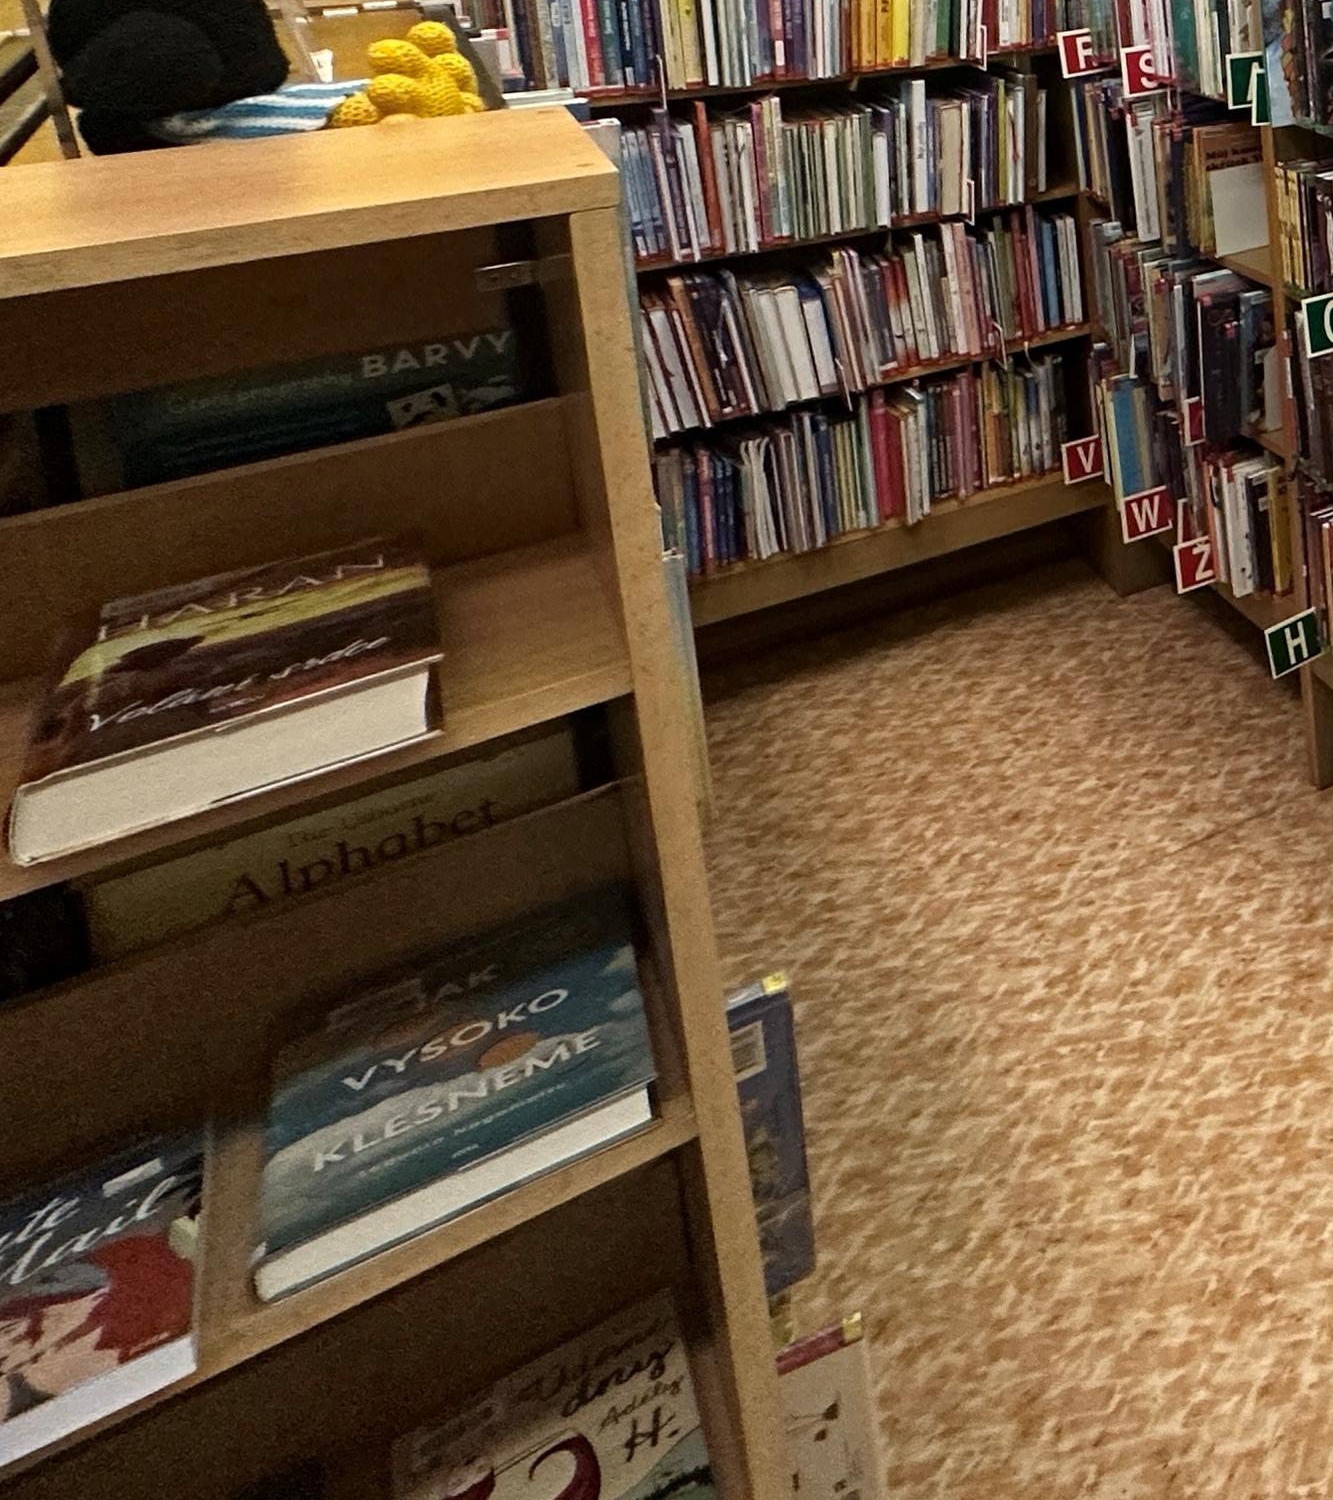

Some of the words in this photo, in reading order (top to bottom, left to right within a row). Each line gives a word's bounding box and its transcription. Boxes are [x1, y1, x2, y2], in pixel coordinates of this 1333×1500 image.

[360, 329, 513, 382] BARVY
[1076, 445, 1096, 474] V
[1131, 496, 1159, 534] W
[1191, 545, 1214, 582] Z
[1285, 629, 1308, 666] H
[229, 795, 506, 905] Alphabet
[341, 984, 572, 1095] VYSOKO
[309, 1029, 608, 1178] KLESNEME
